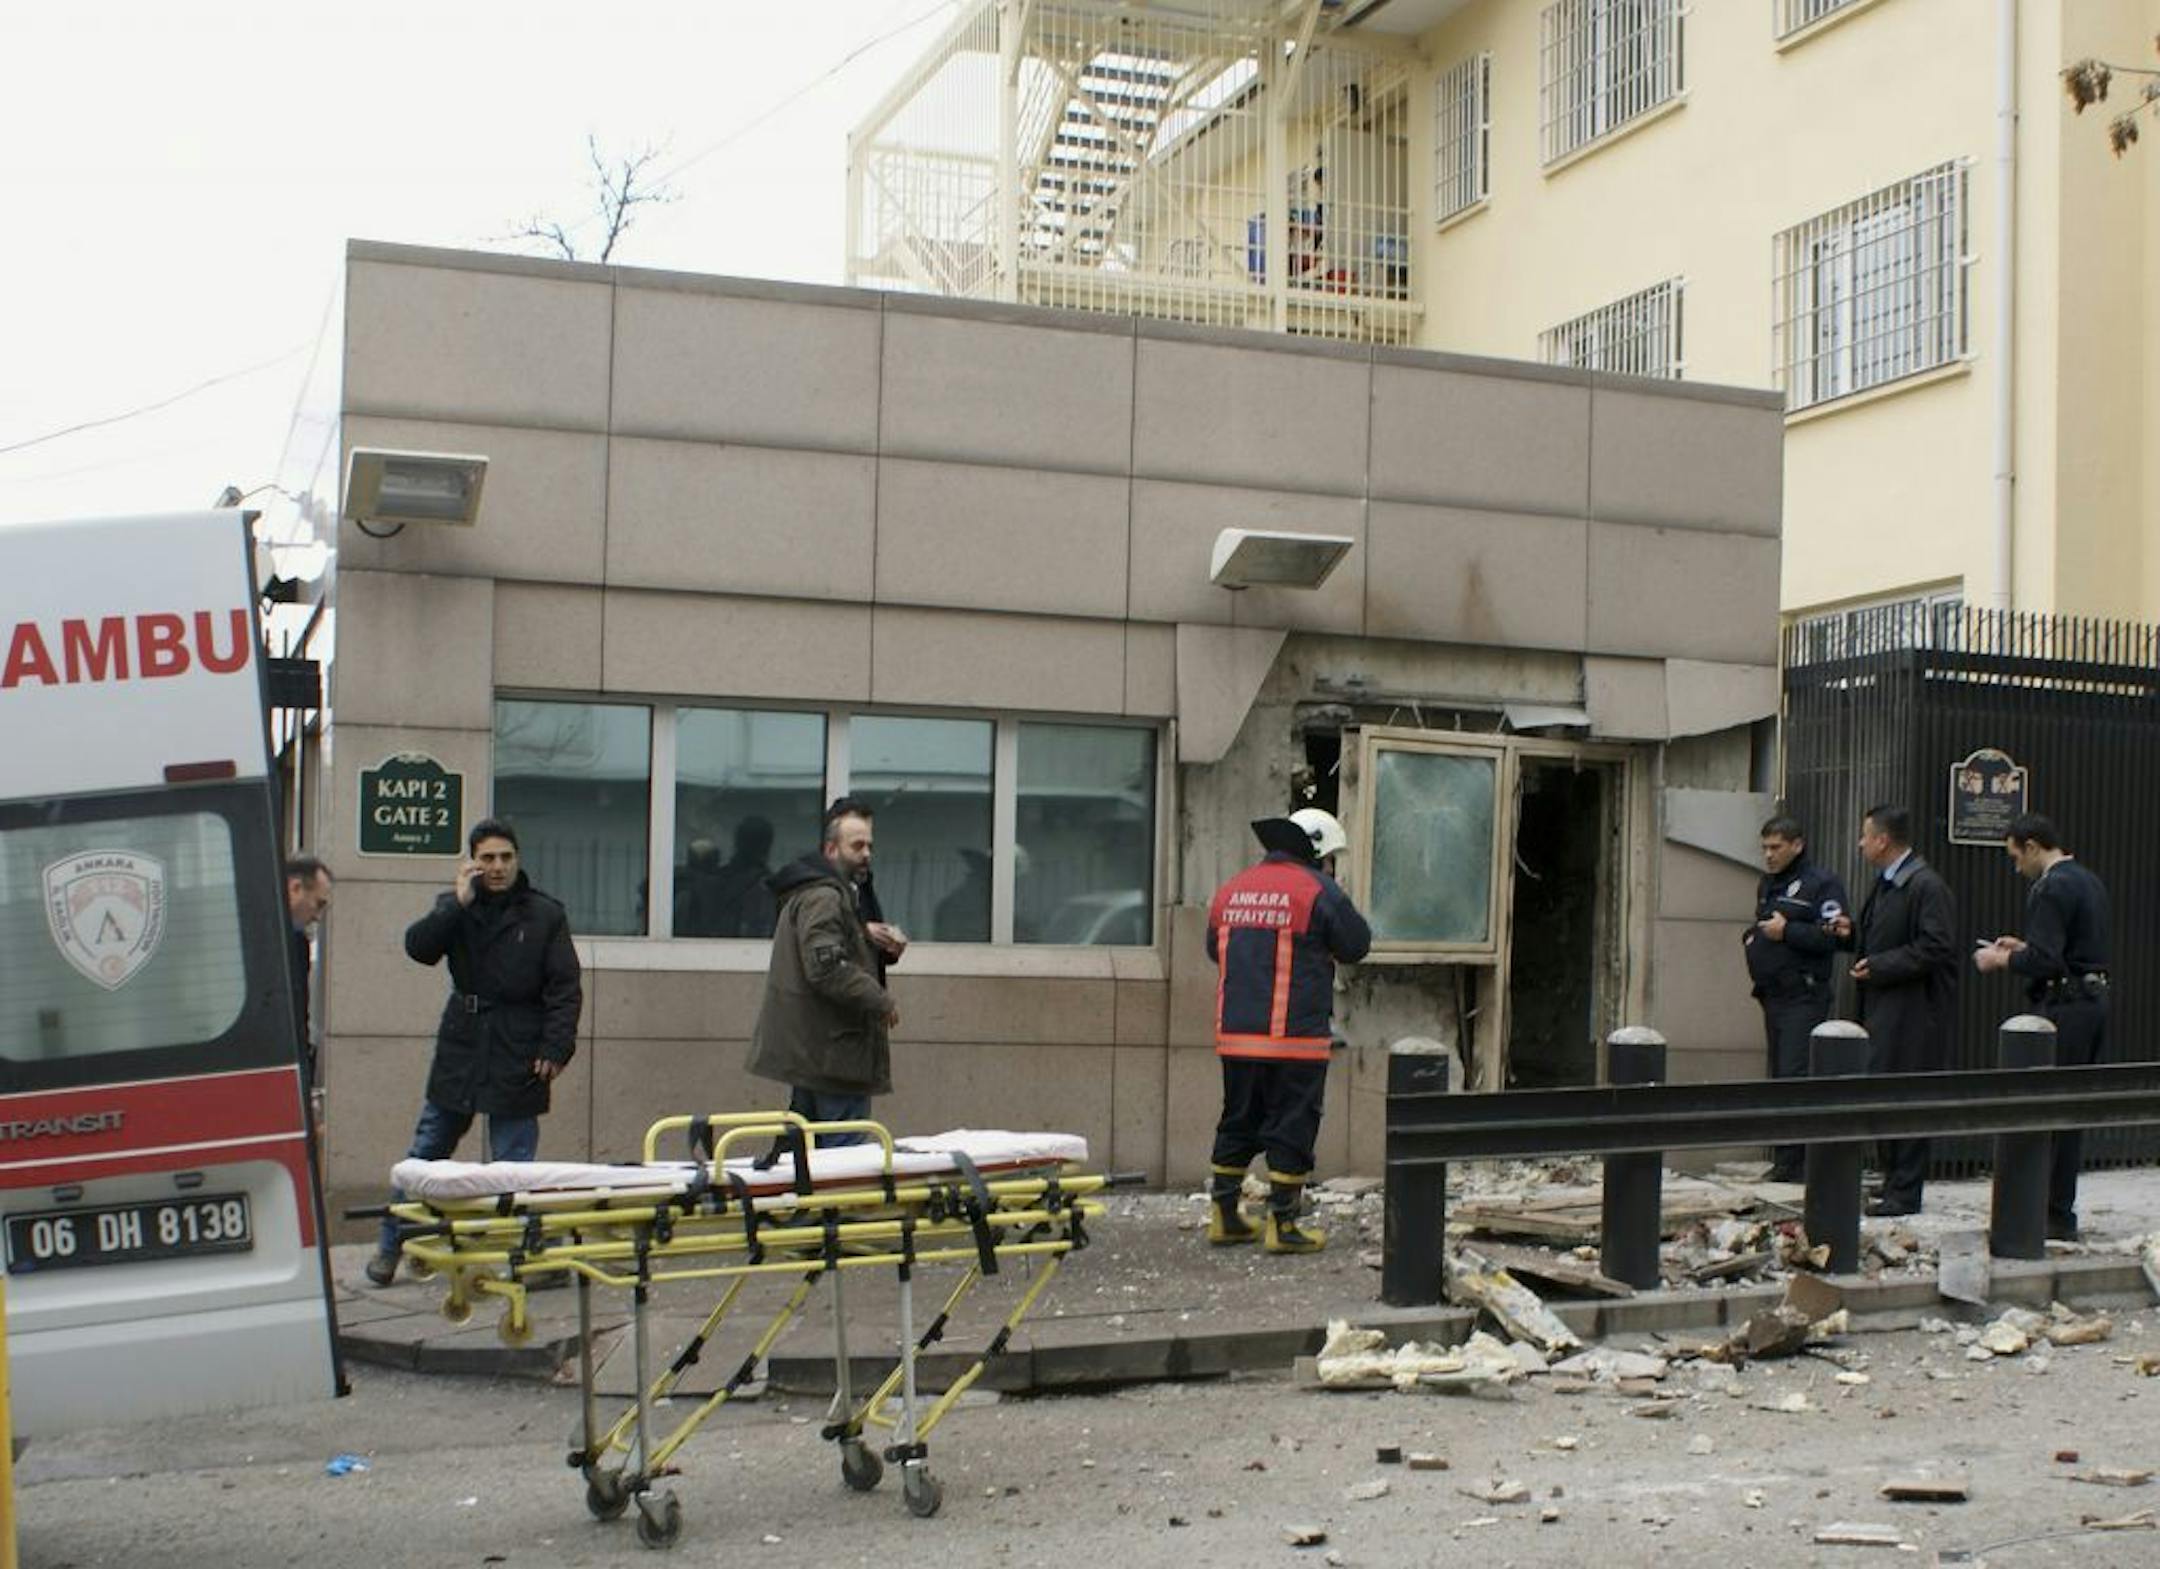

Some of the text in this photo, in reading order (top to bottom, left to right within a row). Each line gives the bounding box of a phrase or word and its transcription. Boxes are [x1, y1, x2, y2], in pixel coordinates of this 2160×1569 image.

[0, 609, 250, 688] AMBU
[377, 779, 447, 800] KAPI 2
[373, 805, 449, 826] GATE 2
[75, 858, 134, 873] ANKARA
[1229, 891, 1290, 907] ANKARA
[0, 1110, 124, 1140] TRANSIT
[32, 1200, 244, 1259] 06 DH 8138
